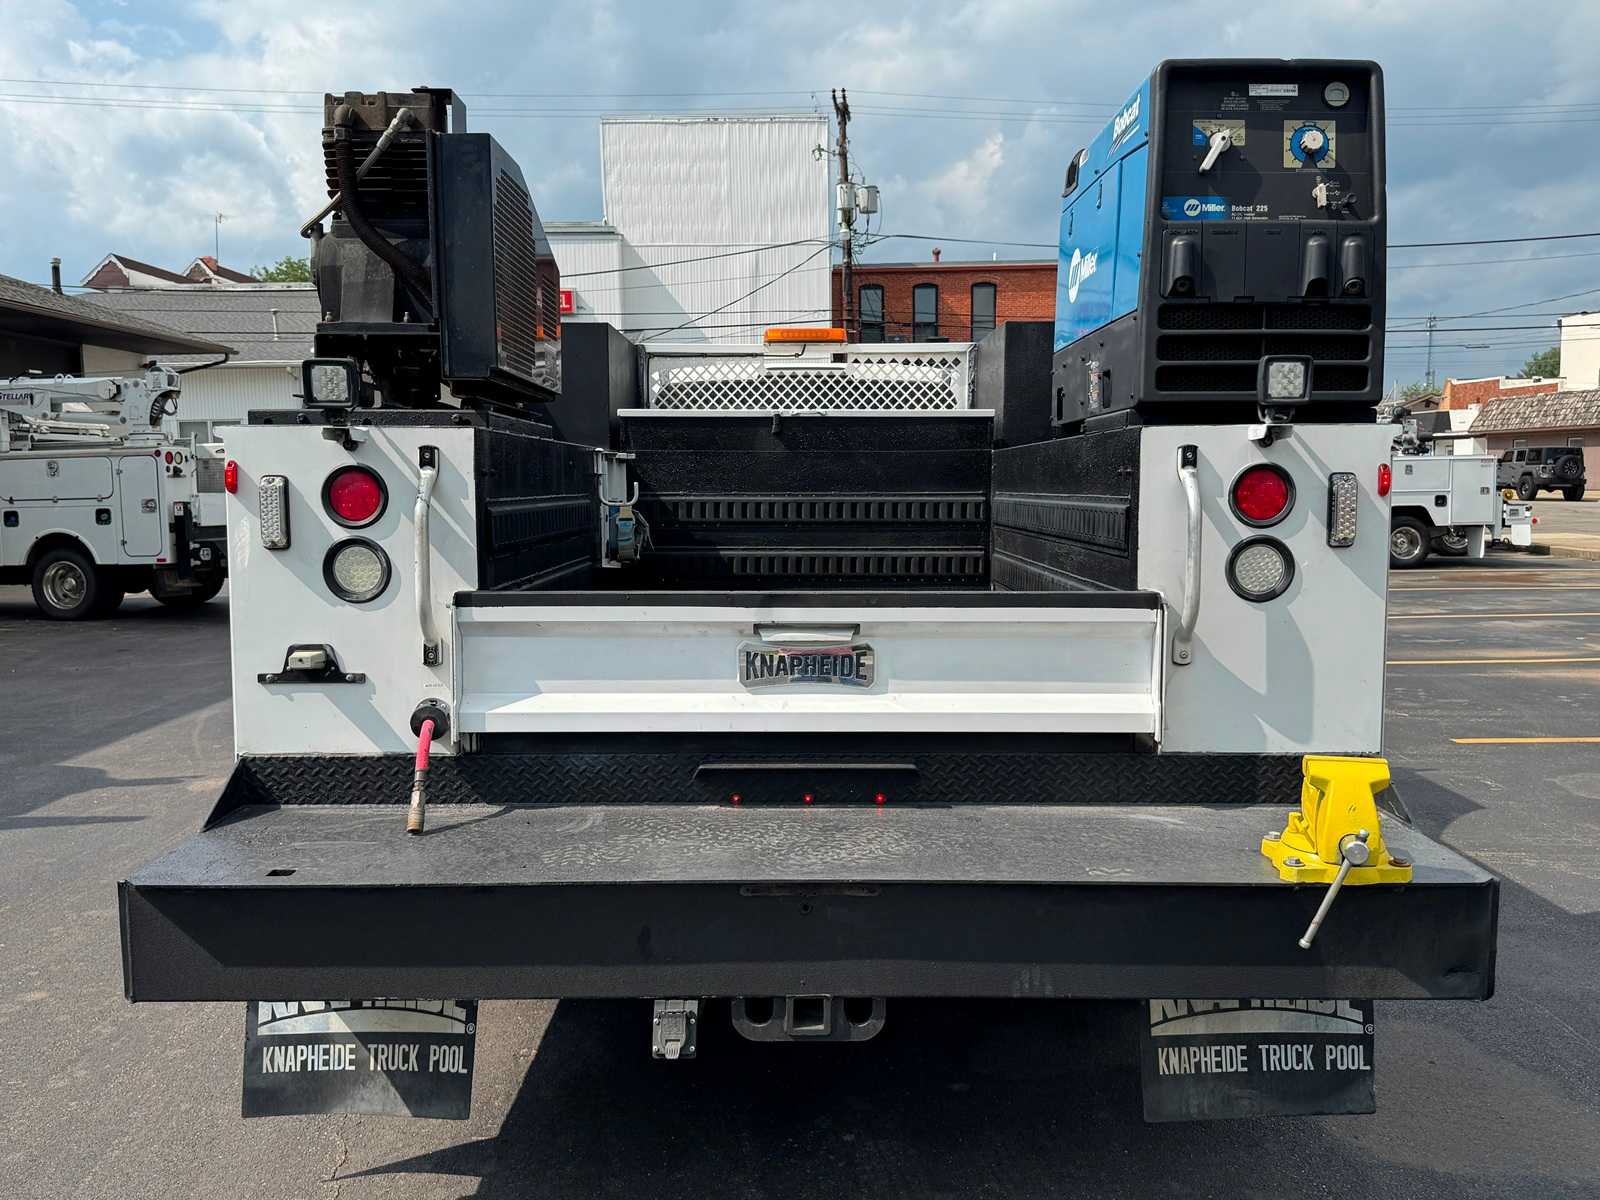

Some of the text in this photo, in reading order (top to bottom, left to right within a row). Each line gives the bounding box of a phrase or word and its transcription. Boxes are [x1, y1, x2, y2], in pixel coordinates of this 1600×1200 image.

[1112, 94, 1140, 140] Bobcat
[1202, 203, 1226, 212] Miller
[1231, 204, 1253, 212] Bobcat
[1080, 252, 1098, 283] Miller
[745, 651, 868, 680] KNAPHEIDE
[262, 1044, 468, 1074] KNAPHEIDE TRUCK POOL
[1158, 1044, 1371, 1075] KNAPHEIDE TRUCK POOL
